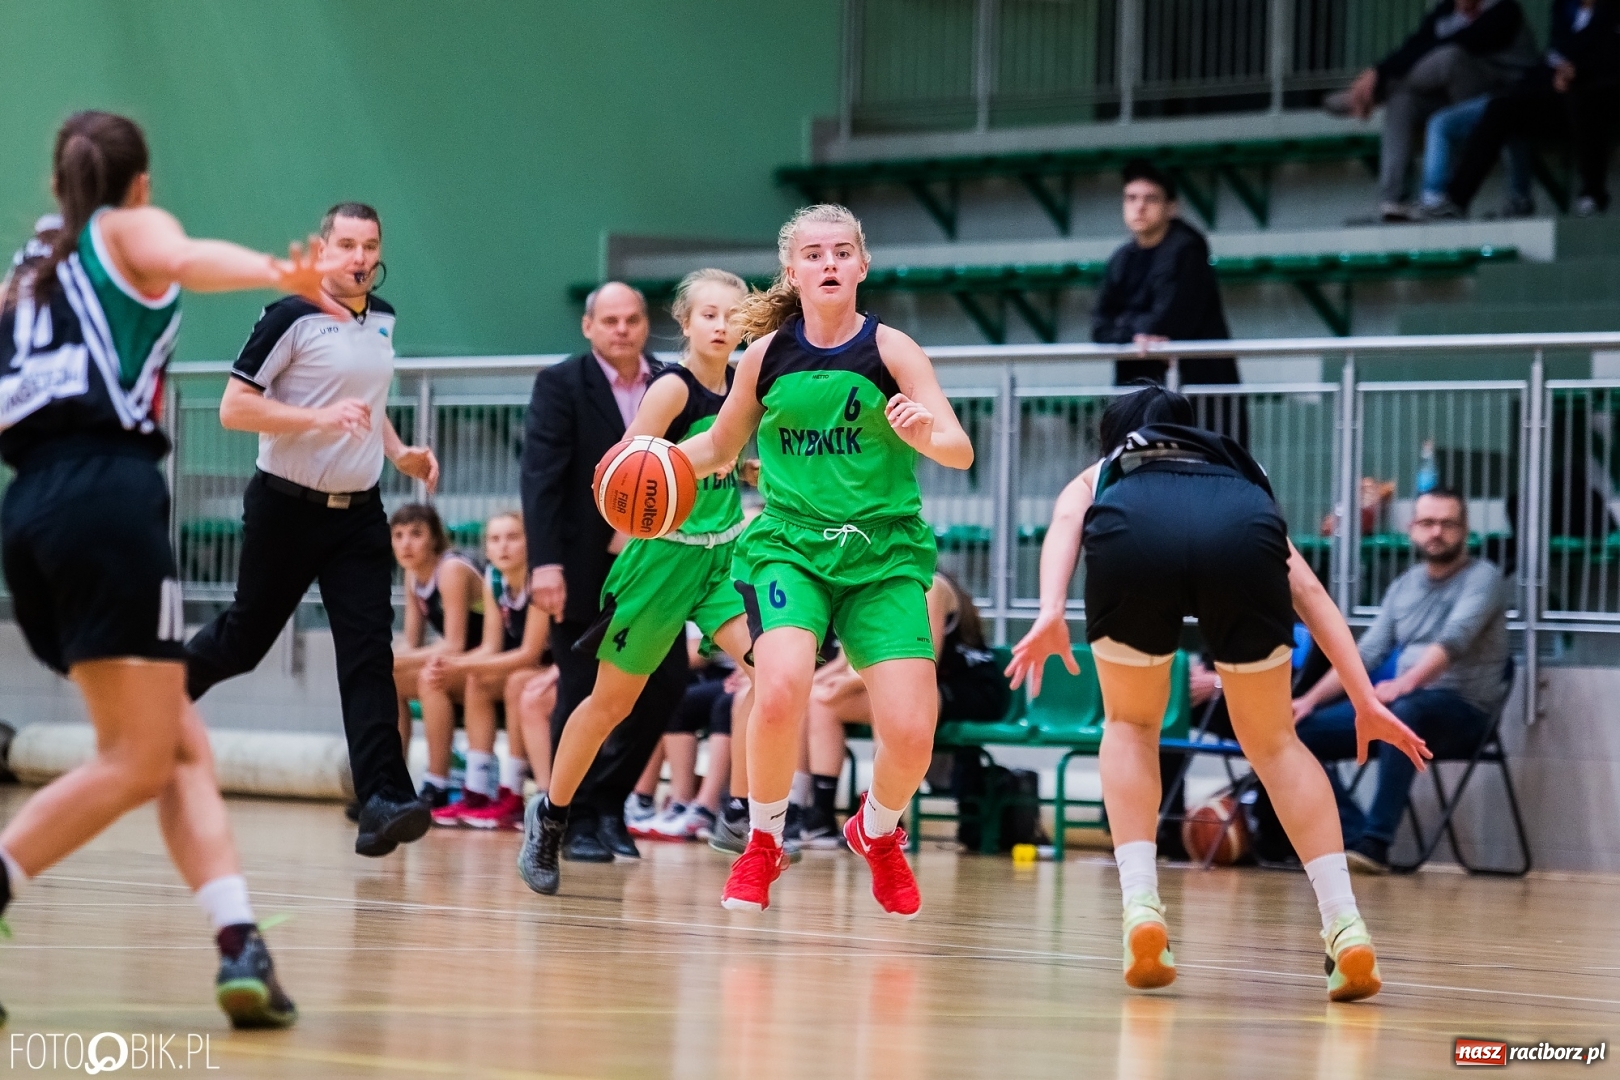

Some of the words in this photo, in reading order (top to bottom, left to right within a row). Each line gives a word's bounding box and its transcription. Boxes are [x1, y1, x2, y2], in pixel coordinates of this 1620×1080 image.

[843, 386, 862, 422] 6
[778, 426, 864, 457] RYBNIK
[616, 491, 629, 514] FIBA
[640, 479, 658, 533] molten
[769, 580, 788, 610] 6
[612, 627, 631, 653] 4
